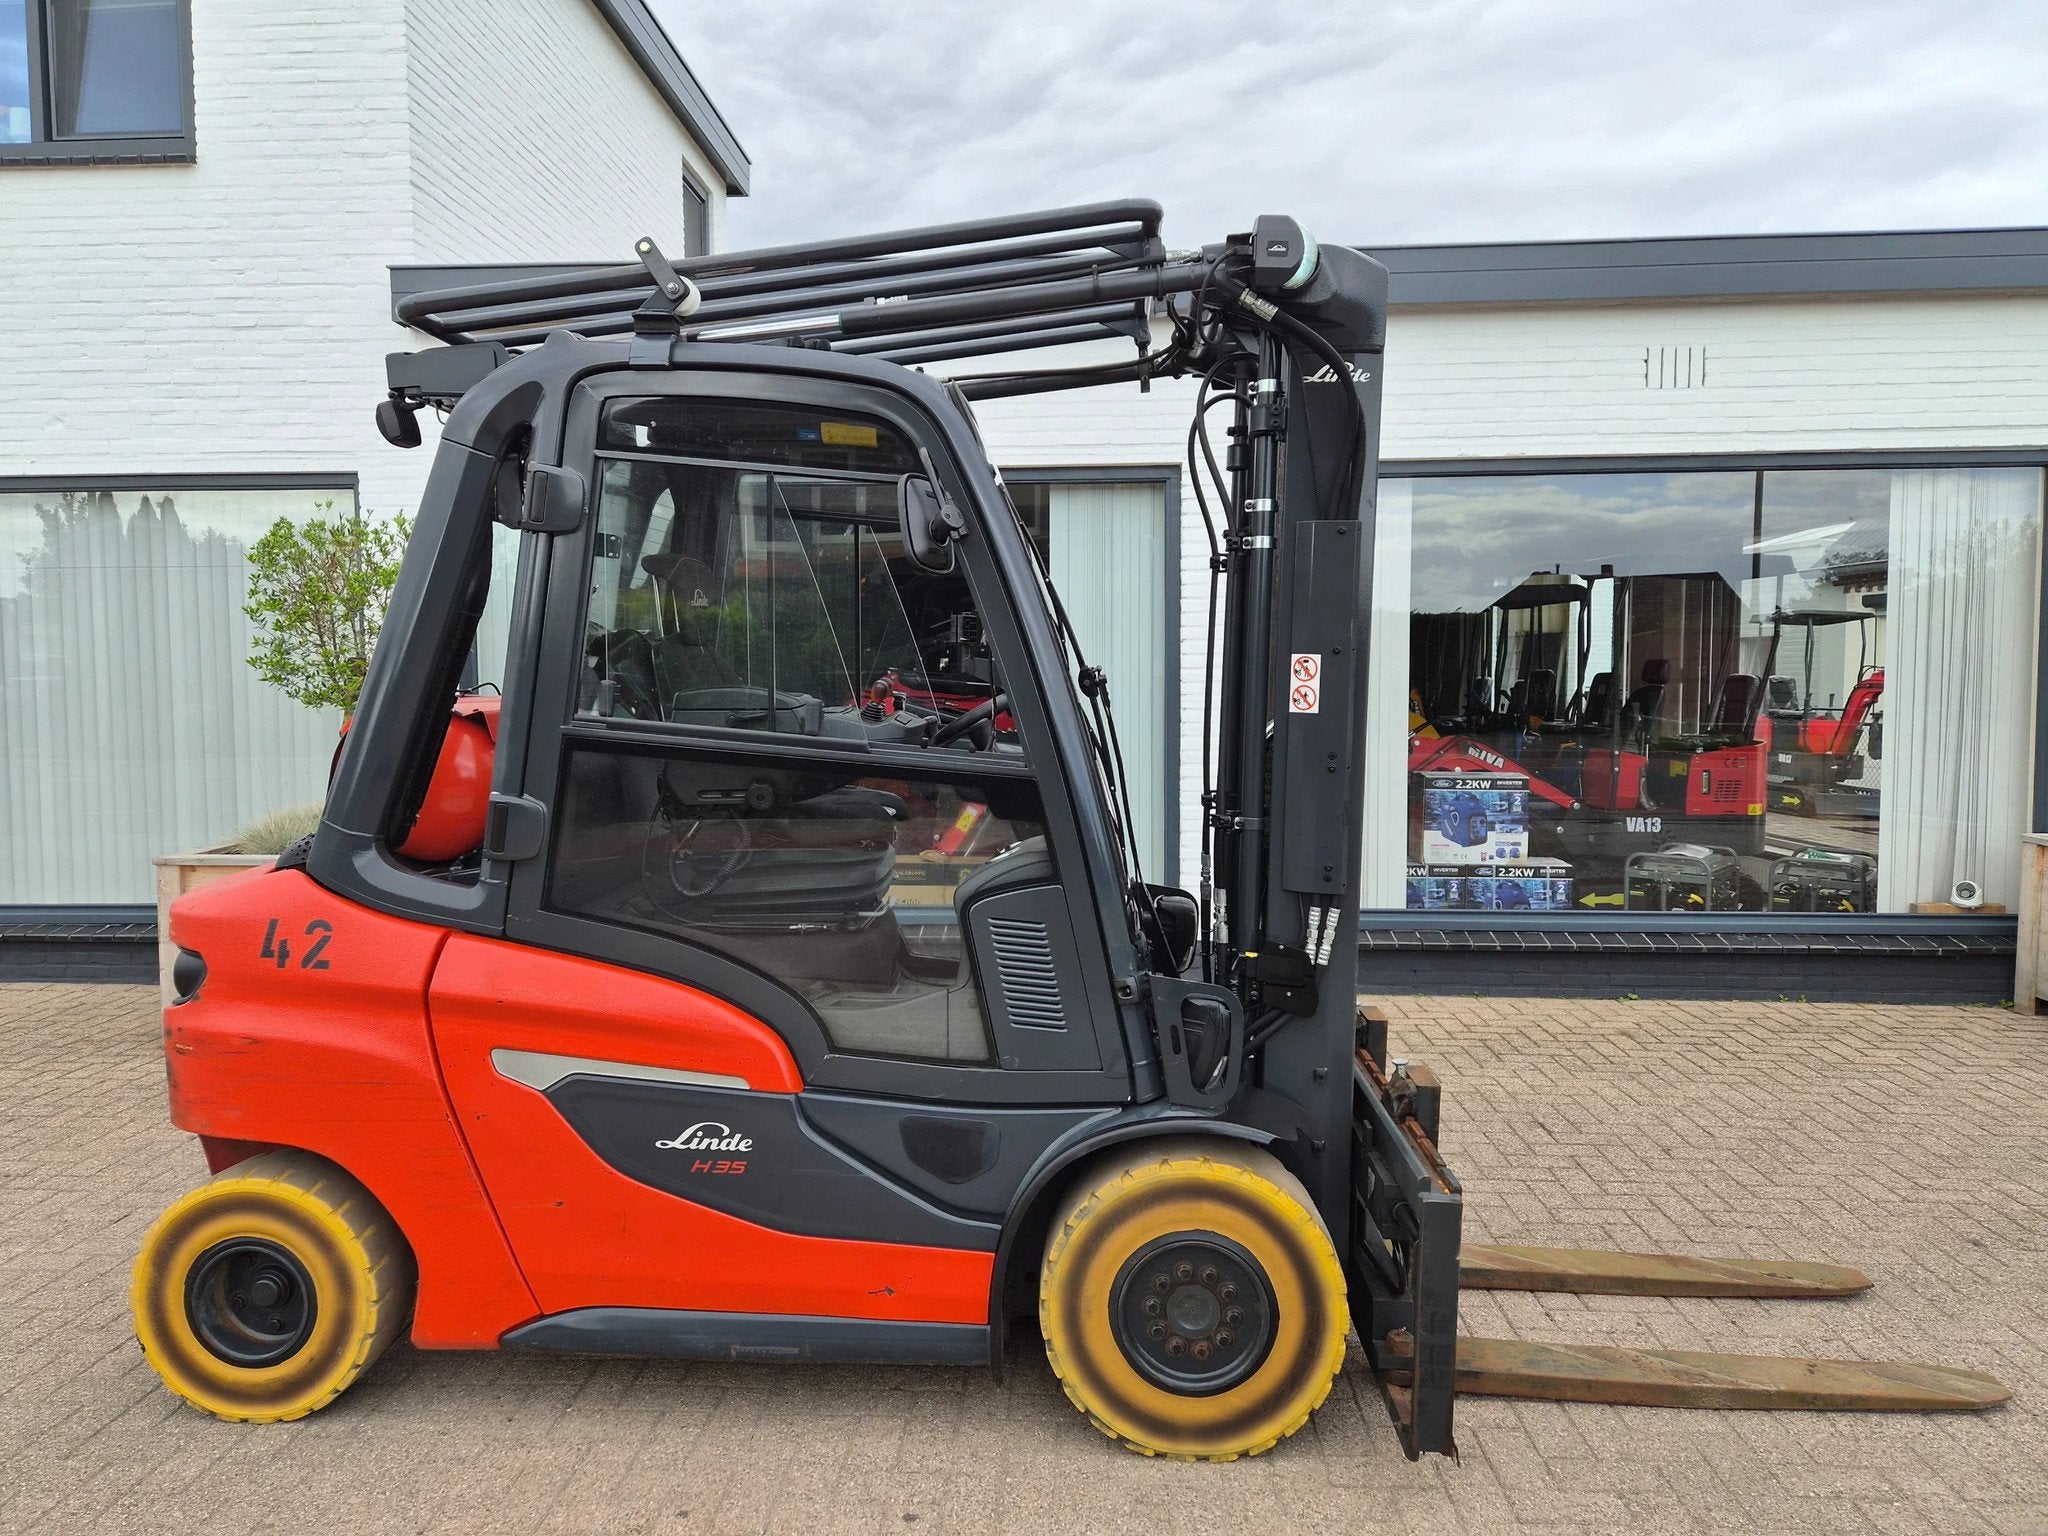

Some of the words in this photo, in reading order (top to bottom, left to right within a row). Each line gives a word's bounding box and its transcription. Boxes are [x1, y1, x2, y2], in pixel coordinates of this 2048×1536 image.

[1455, 780, 1491, 789] 2.2KW
[1626, 817, 1662, 833] VA13
[1498, 868, 1534, 877] 2.2KW
[260, 918, 333, 970] 42
[655, 1121, 753, 1152] Linde
